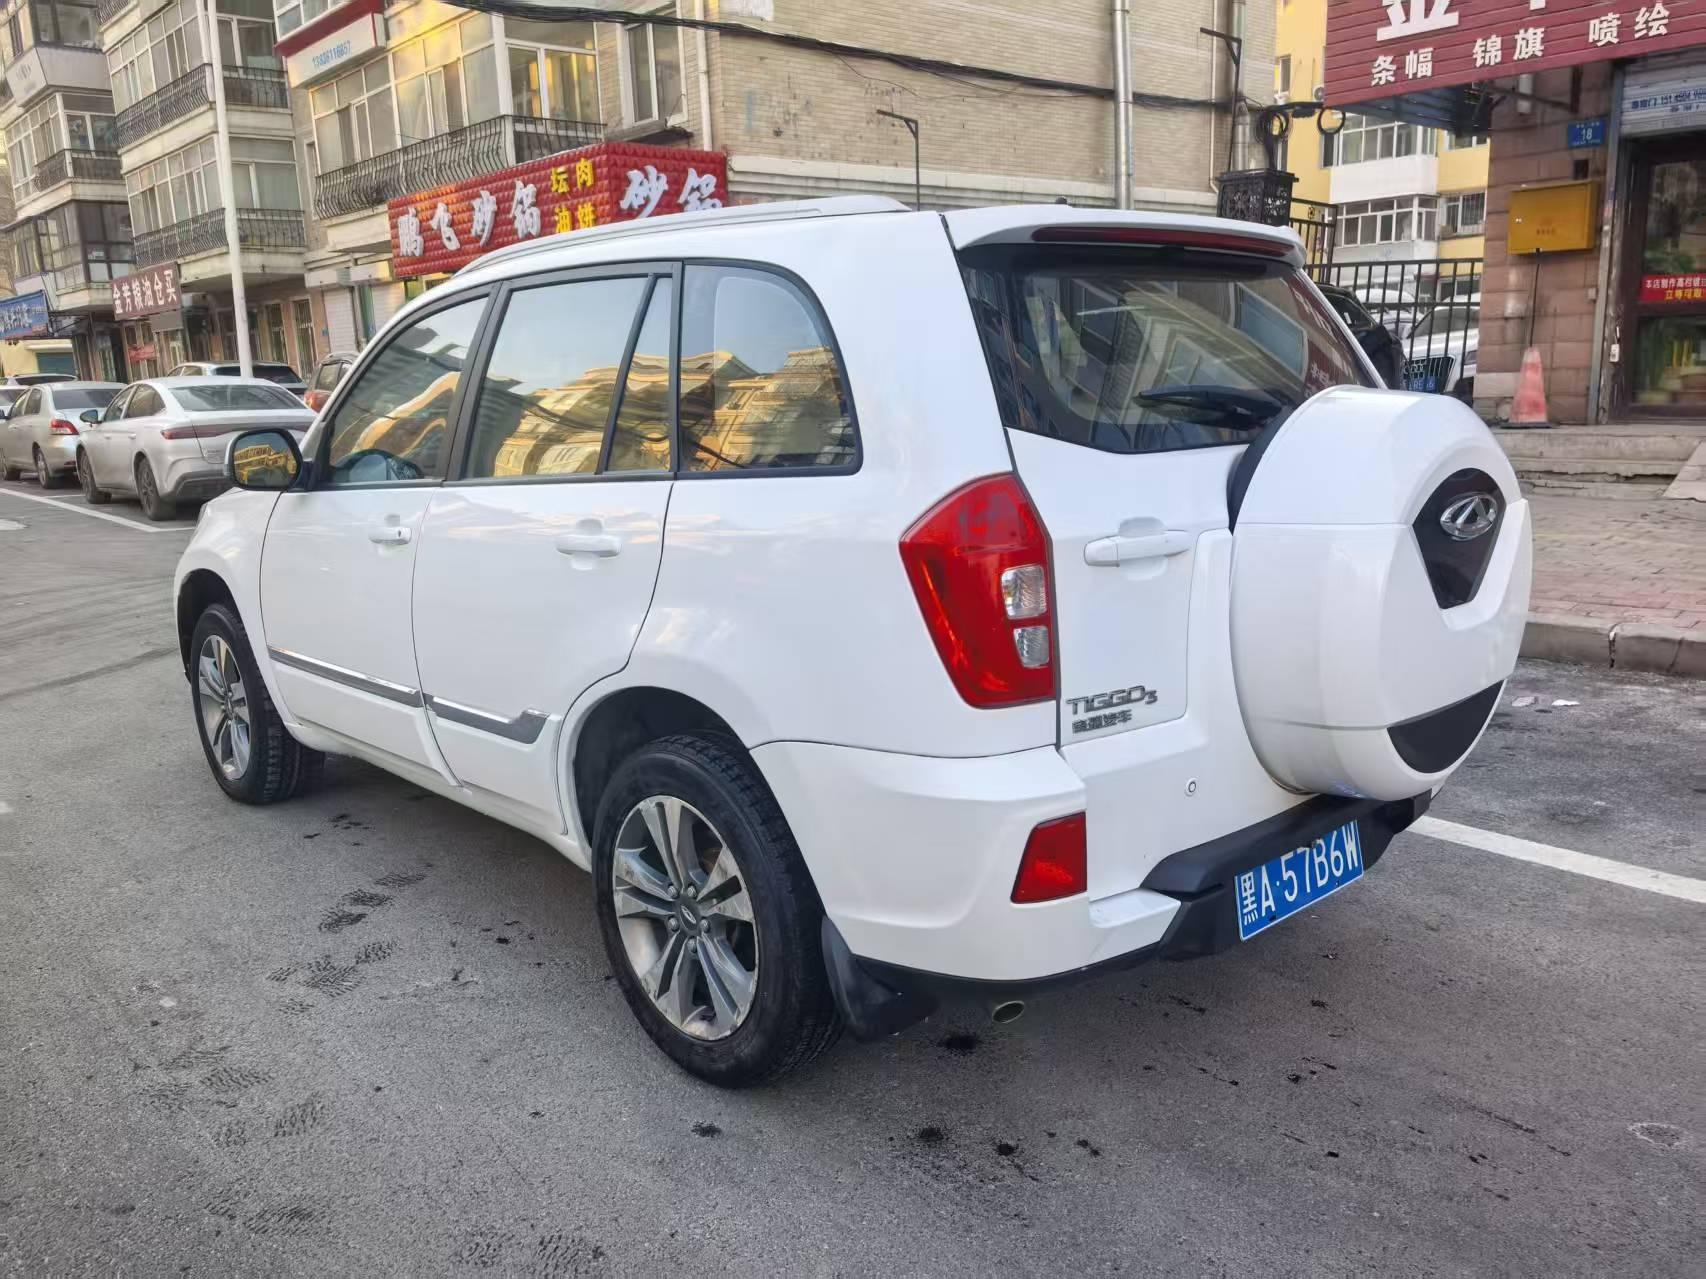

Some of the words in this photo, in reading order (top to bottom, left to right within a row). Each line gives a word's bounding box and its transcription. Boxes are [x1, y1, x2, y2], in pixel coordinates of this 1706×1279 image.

[1370, 47, 1434, 87] 条幅
[1472, 27, 1545, 68] 锦旗
[1587, 2, 1670, 47] 喷绘
[550, 158, 595, 193] 坛肉
[619, 165, 723, 219] 砂锅
[554, 201, 597, 234] 油饼
[112, 269, 177, 314] 金芳粮油仓买
